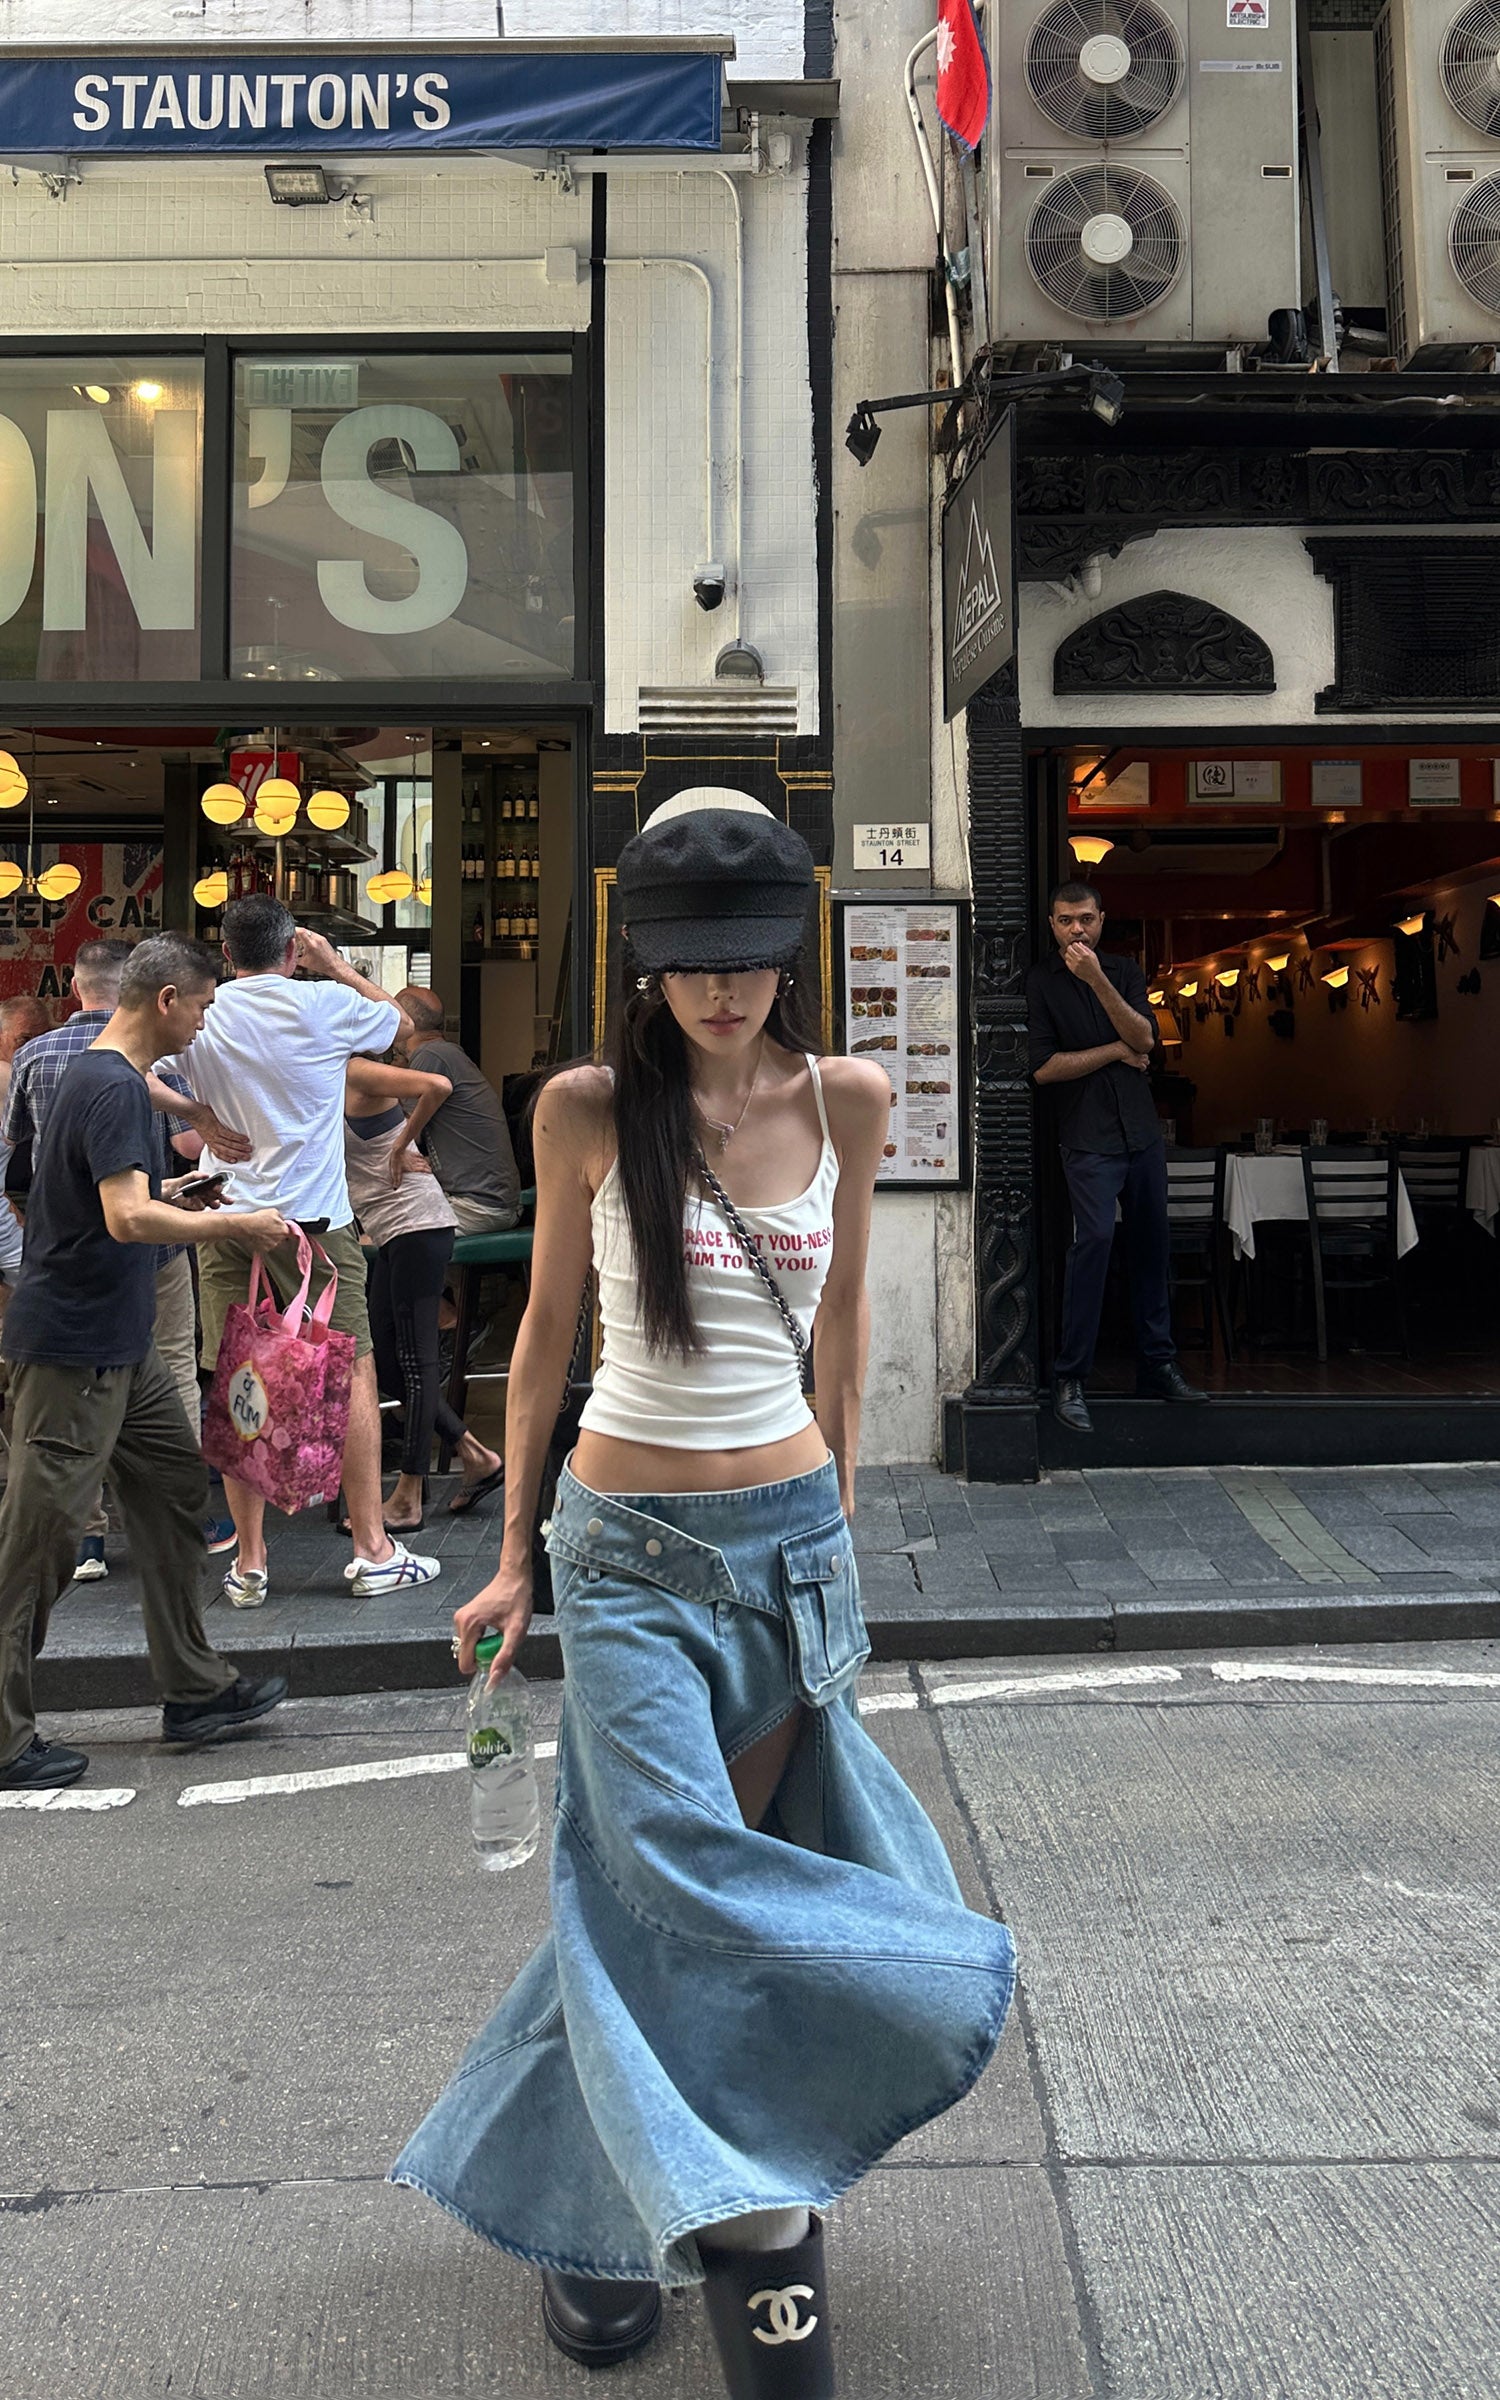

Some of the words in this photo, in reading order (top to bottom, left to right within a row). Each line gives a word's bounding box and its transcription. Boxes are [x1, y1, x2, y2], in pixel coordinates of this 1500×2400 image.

[73, 73, 451, 131] STAUNTON'S
[956, 574, 995, 641] NEPAL
[977, 612, 1006, 653] Cuisine
[879, 848, 904, 866] 14
[897, 839, 920, 847] STREET
[720, 1254, 743, 1269] TO
[774, 1257, 817, 1271] YOU.
